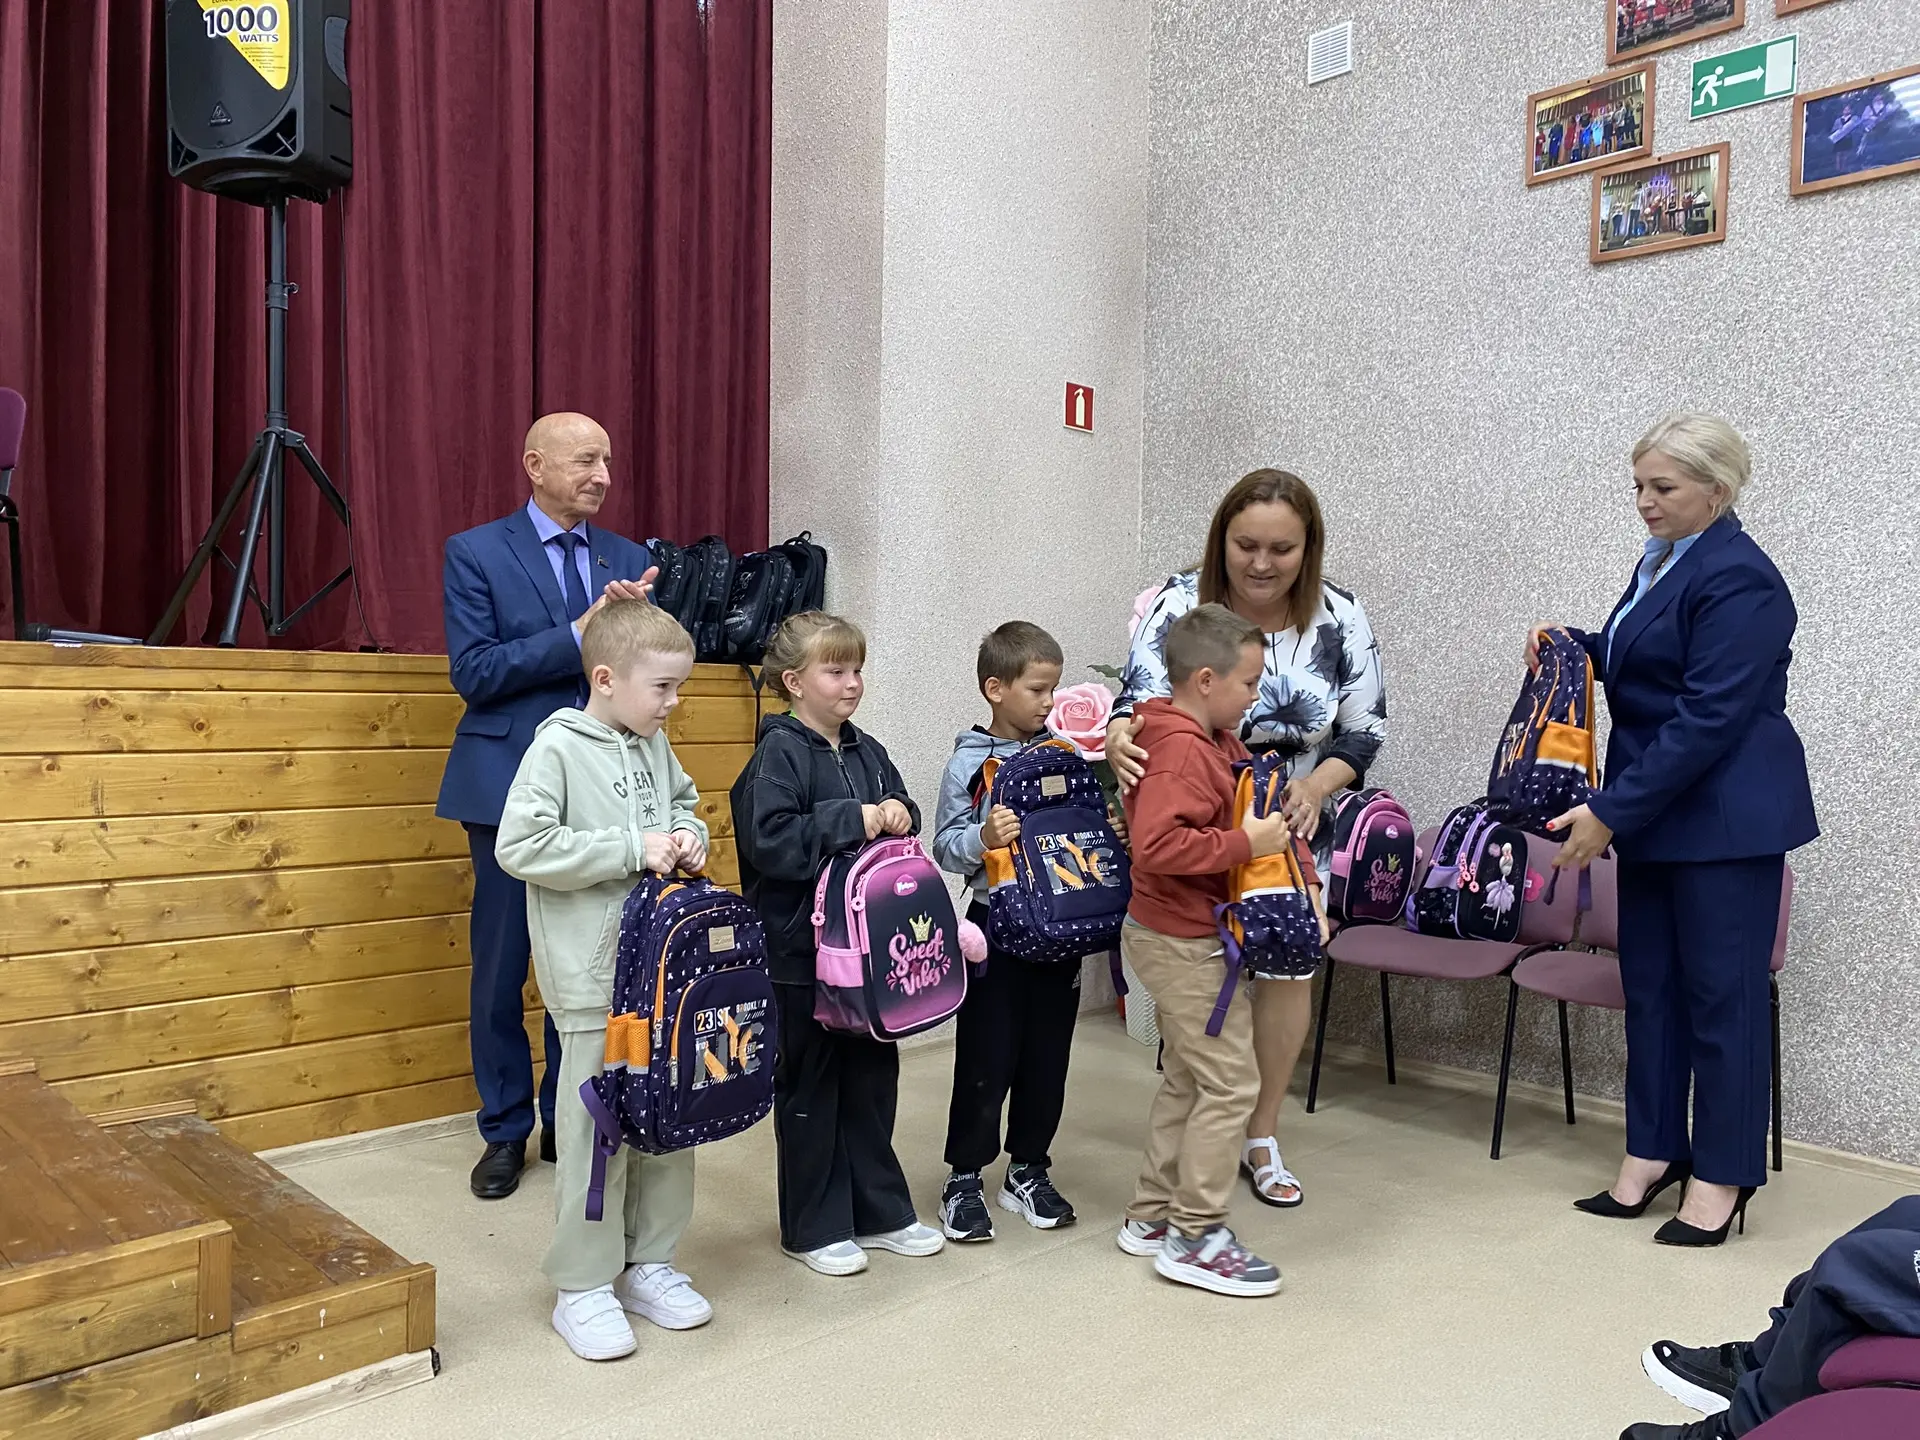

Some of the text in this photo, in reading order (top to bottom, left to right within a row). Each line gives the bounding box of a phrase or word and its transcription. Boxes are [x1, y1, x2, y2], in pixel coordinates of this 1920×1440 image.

[204, 5, 278, 35] 1000
[239, 33, 279, 43] WATTS
[1038, 834, 1068, 851] 23 ST
[889, 927, 944, 977] Sweet
[899, 959, 941, 996] Vibes
[697, 1006, 731, 1032] 23 ST
